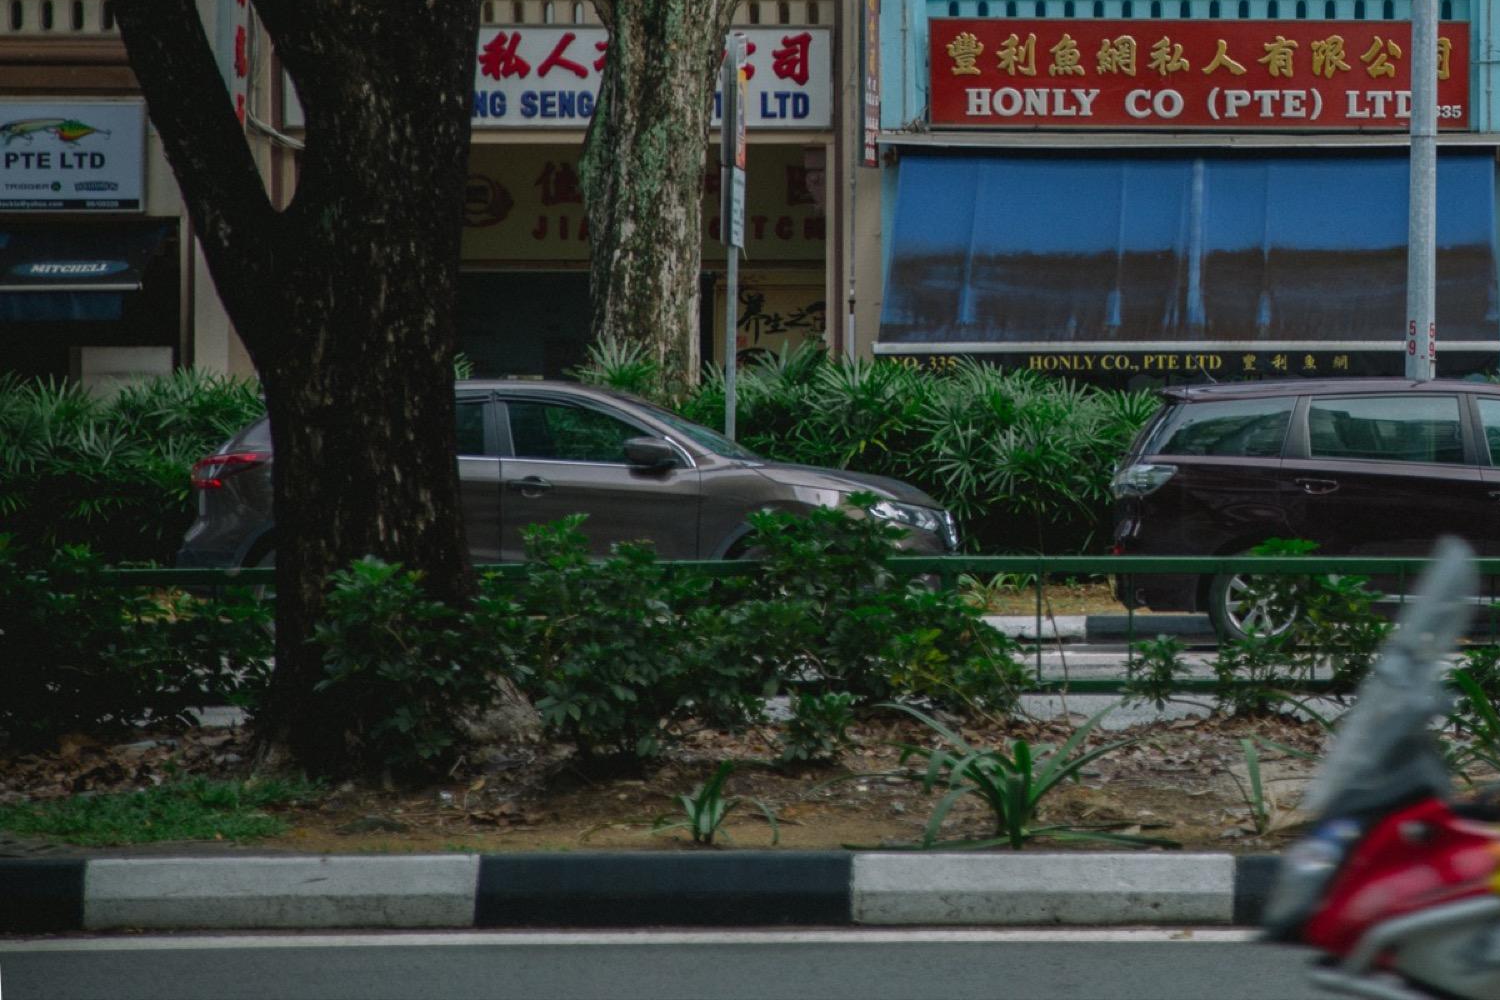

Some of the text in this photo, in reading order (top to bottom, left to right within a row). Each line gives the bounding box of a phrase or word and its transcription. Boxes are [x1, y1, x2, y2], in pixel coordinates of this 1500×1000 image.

[520, 91, 594, 118] SENG
[760, 92, 810, 119] LTD
[965, 87, 1099, 118] HONLY
[1124, 88, 1185, 119] CO
[1206, 88, 1323, 121] (PTE)
[5, 152, 106, 170] PTE LTD
[30, 263, 109, 274] MITCHELL
[1029, 355, 1098, 370] HONLY
[1143, 354, 1180, 370] PTE
[1185, 354, 1223, 370] LTD
